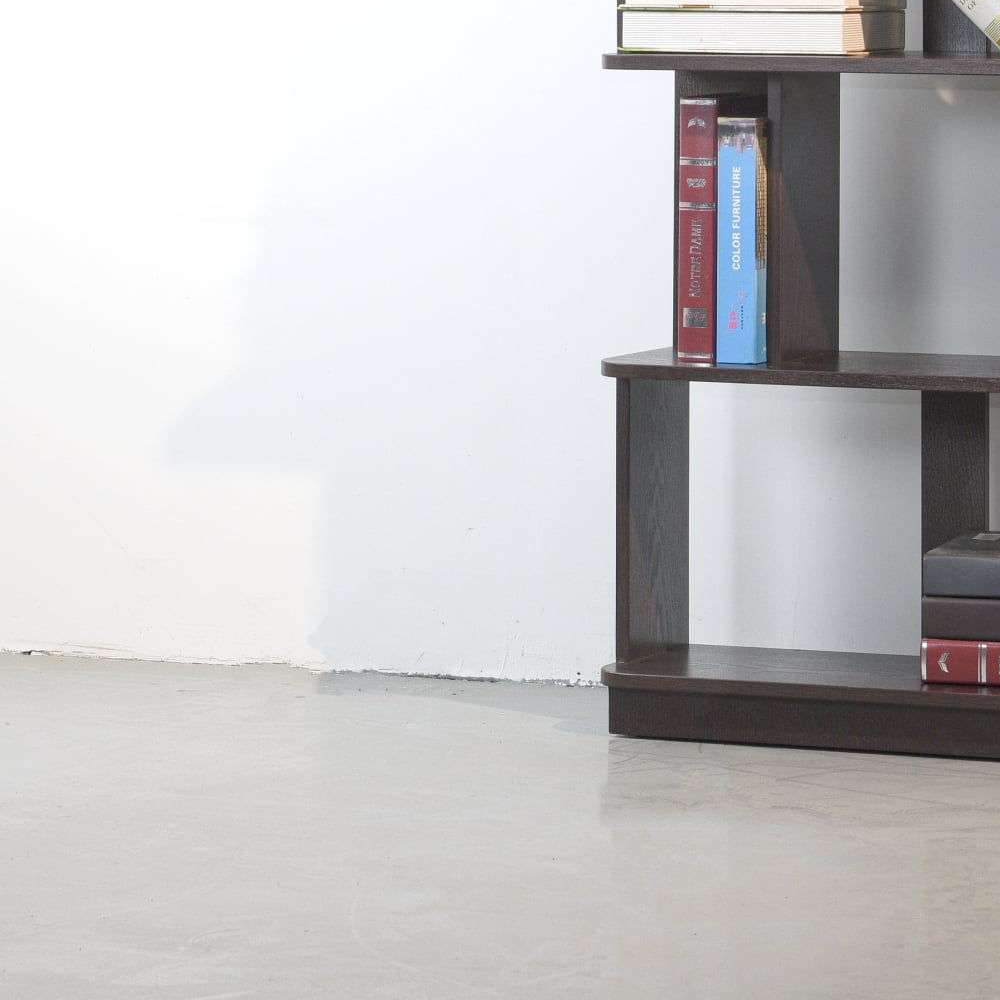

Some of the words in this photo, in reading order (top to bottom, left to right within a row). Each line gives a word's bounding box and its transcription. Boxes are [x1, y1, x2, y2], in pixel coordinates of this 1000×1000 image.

[732, 166, 742, 227] FURNITURE
[689, 219, 702, 254] DAME
[732, 230, 742, 270] COLOR
[689, 258, 701, 298] NOTRE
